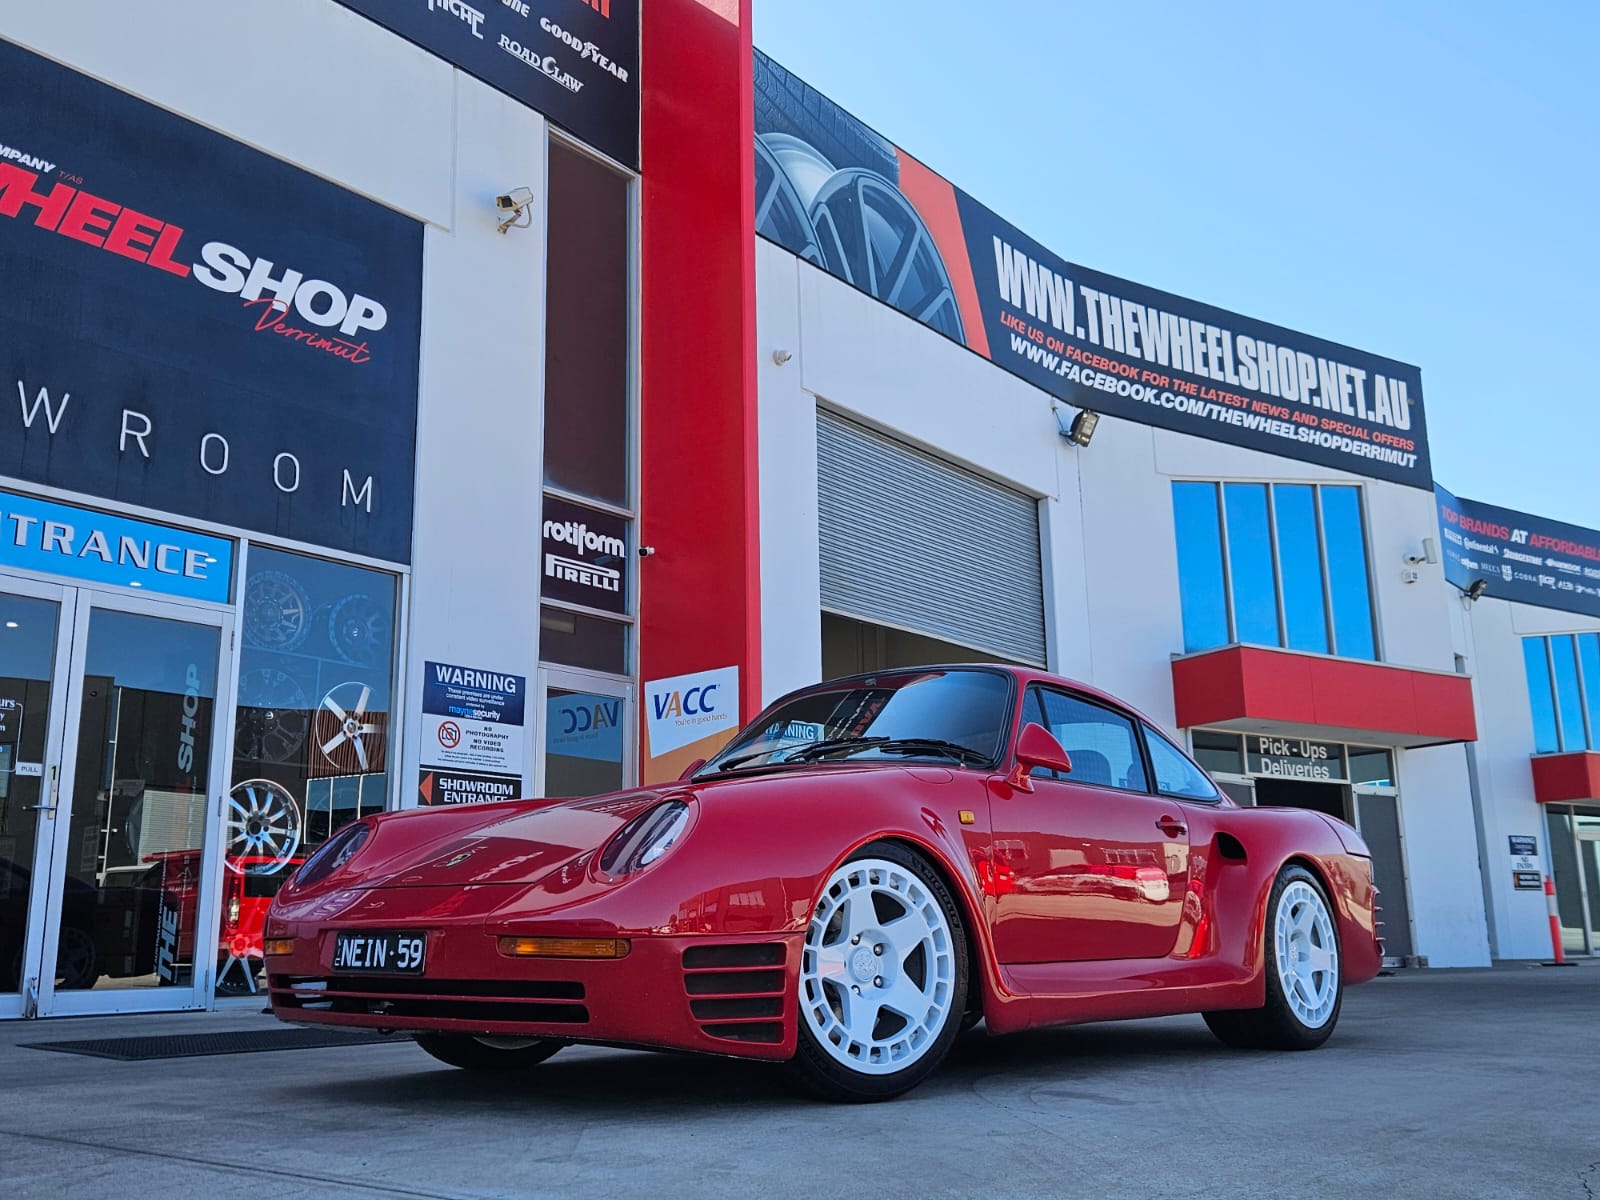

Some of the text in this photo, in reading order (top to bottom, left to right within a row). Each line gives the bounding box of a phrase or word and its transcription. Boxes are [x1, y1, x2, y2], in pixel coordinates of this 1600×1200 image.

[540, 17, 629, 83] GOODYEAR
[0, 162, 387, 337] HEEL SHOP
[243, 298, 370, 364] Derrimut
[993, 235, 1411, 431] WWW.THEWHEELSHOP.NET.AU
[1000, 310, 1415, 451] LIKE US ON FACEBOOK FOR THE LATEST NEWS AND SPECIAL OFFERS
[1010, 333, 1418, 468] WWW.FACEBOOK.COM/THEWHEELSHOPDERRIMUT
[543, 519, 625, 558] rotiform
[1441, 504, 1458, 524] TOP
[1460, 514, 1510, 540] BRANDS
[1510, 528, 1528, 544] AT
[0, 511, 209, 581] TRANCE
[545, 553, 621, 592] PIRELLI
[436, 665, 516, 694] WARNING
[178, 663, 200, 773] SHOP
[653, 684, 717, 720] VACC
[465, 730, 509, 740] PHOTOGRAPHY
[483, 739, 502, 747] VIDEO
[765, 721, 815, 740] WANING
[1259, 737, 1290, 756] Pick
[1300, 741, 1328, 762] Ups
[440, 778, 513, 796] SHOWROOM
[1260, 758, 1329, 778] Deliveries
[158, 905, 178, 981] THE
